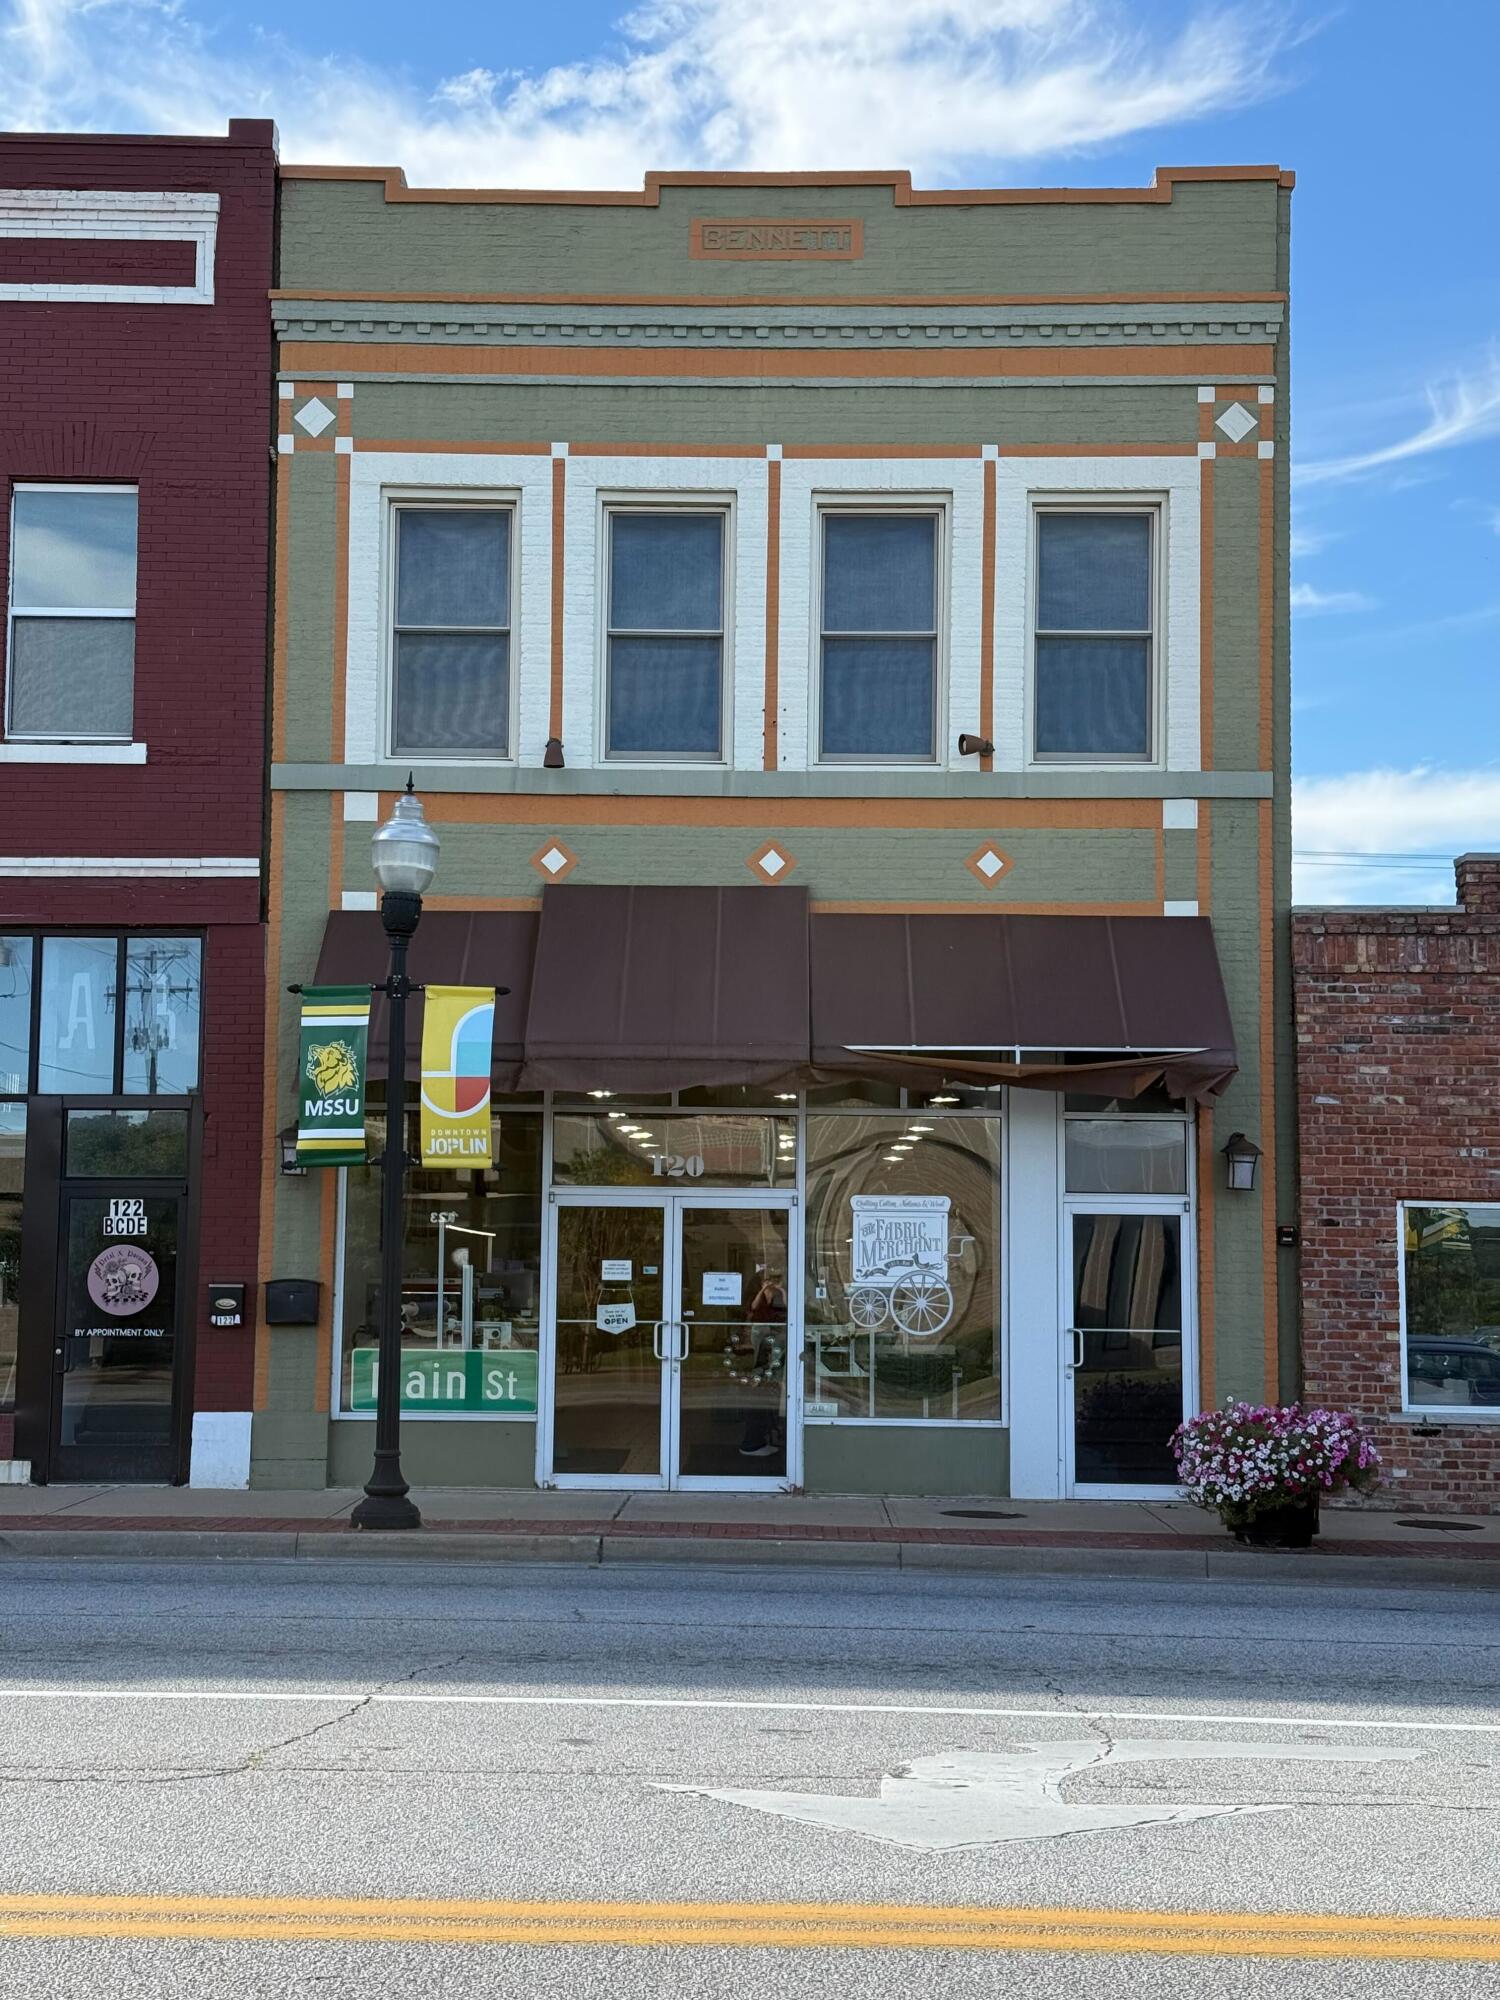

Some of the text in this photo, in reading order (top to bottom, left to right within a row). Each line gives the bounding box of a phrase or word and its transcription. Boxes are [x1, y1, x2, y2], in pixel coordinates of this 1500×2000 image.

[704, 228, 851, 250] BENNETT
[305, 1099, 359, 1116] MSSU
[426, 1138, 487, 1155] JOPLIN
[650, 1152, 704, 1177] 120
[113, 1200, 142, 1216] 122
[104, 1218, 146, 1234] BCDE
[875, 1219, 926, 1241] FABRIC
[861, 1238, 941, 1268] MERCHANT
[604, 1317, 628, 1325] OPEN
[372, 1362, 518, 1400] ain St
